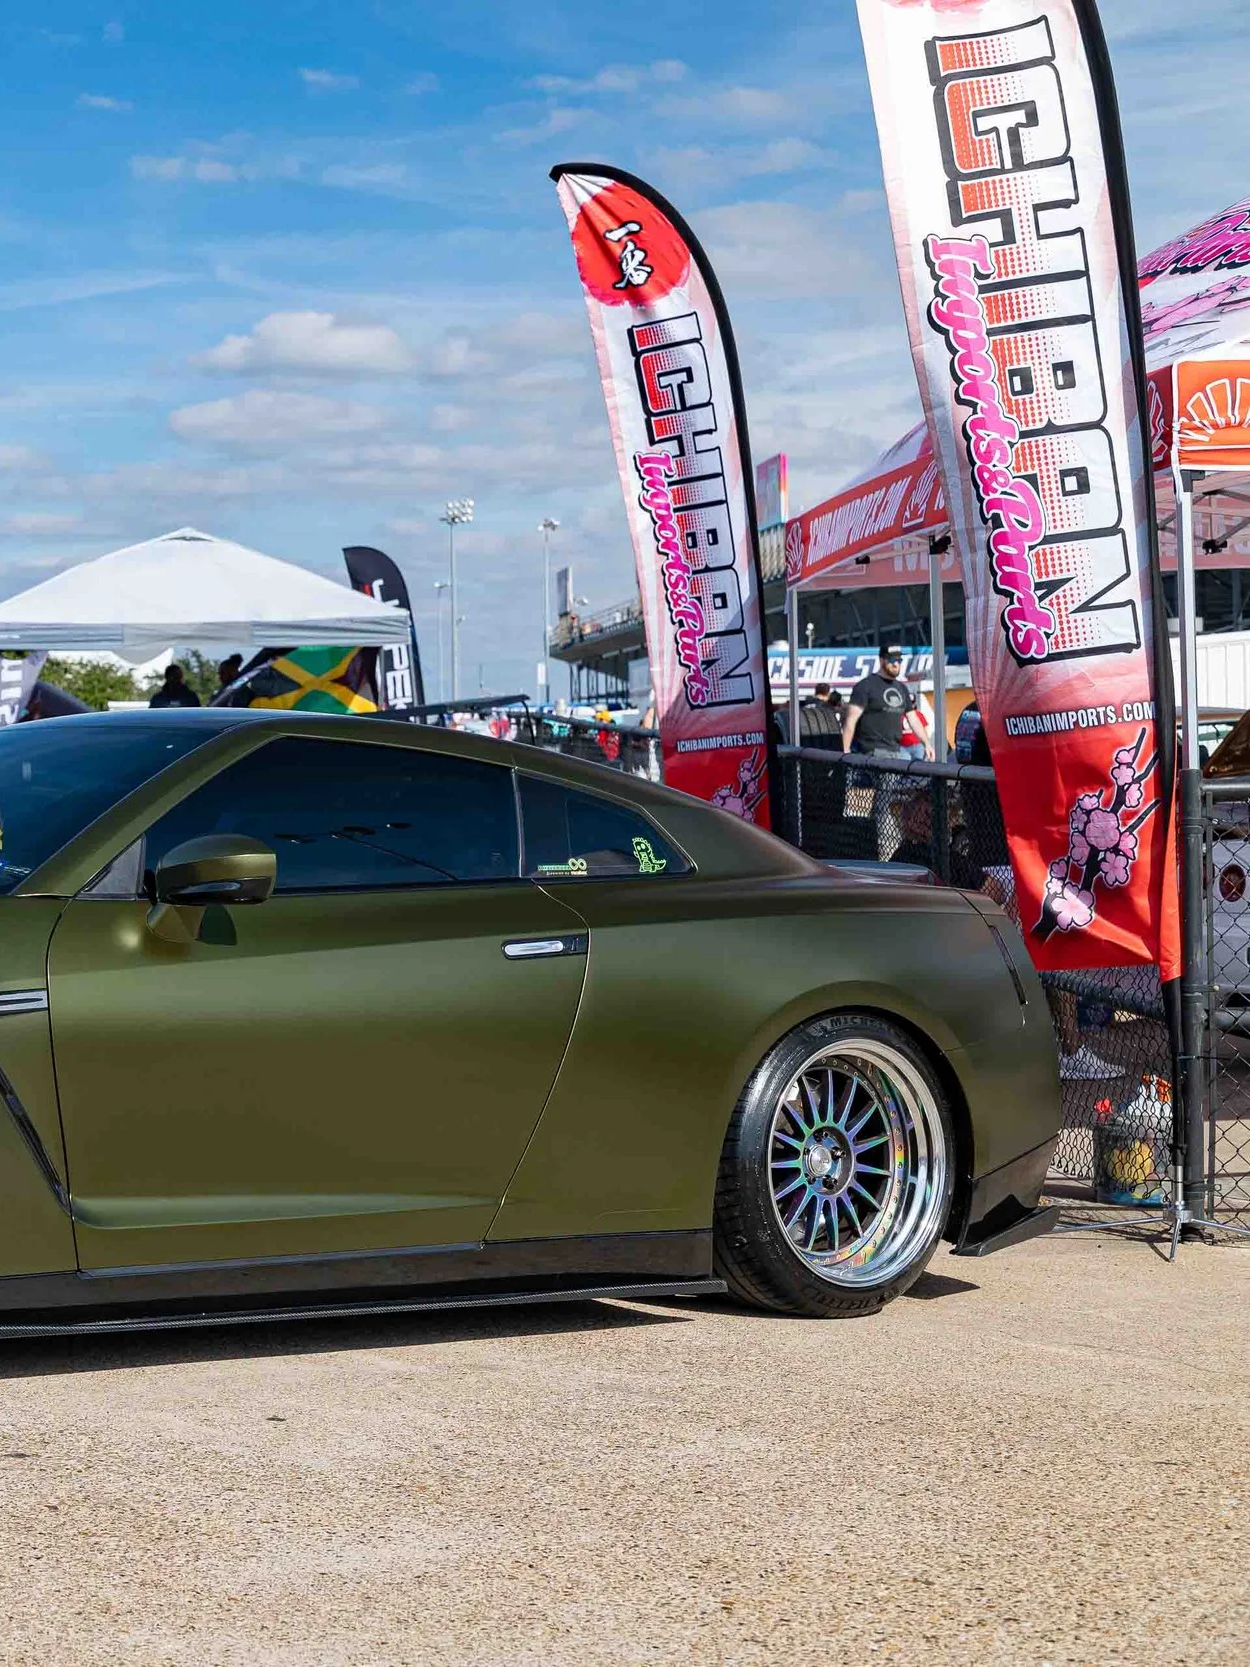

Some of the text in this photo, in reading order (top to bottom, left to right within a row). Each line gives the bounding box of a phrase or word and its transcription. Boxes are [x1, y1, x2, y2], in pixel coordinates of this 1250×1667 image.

[925, 15, 1141, 662] ICHIBAN
[628, 311, 754, 708] ICHIBAN
[676, 731, 764, 753] ICHIBANIMPORTS.COM
[1004, 700, 1157, 736] ICHIBANIMPORTS.COM
